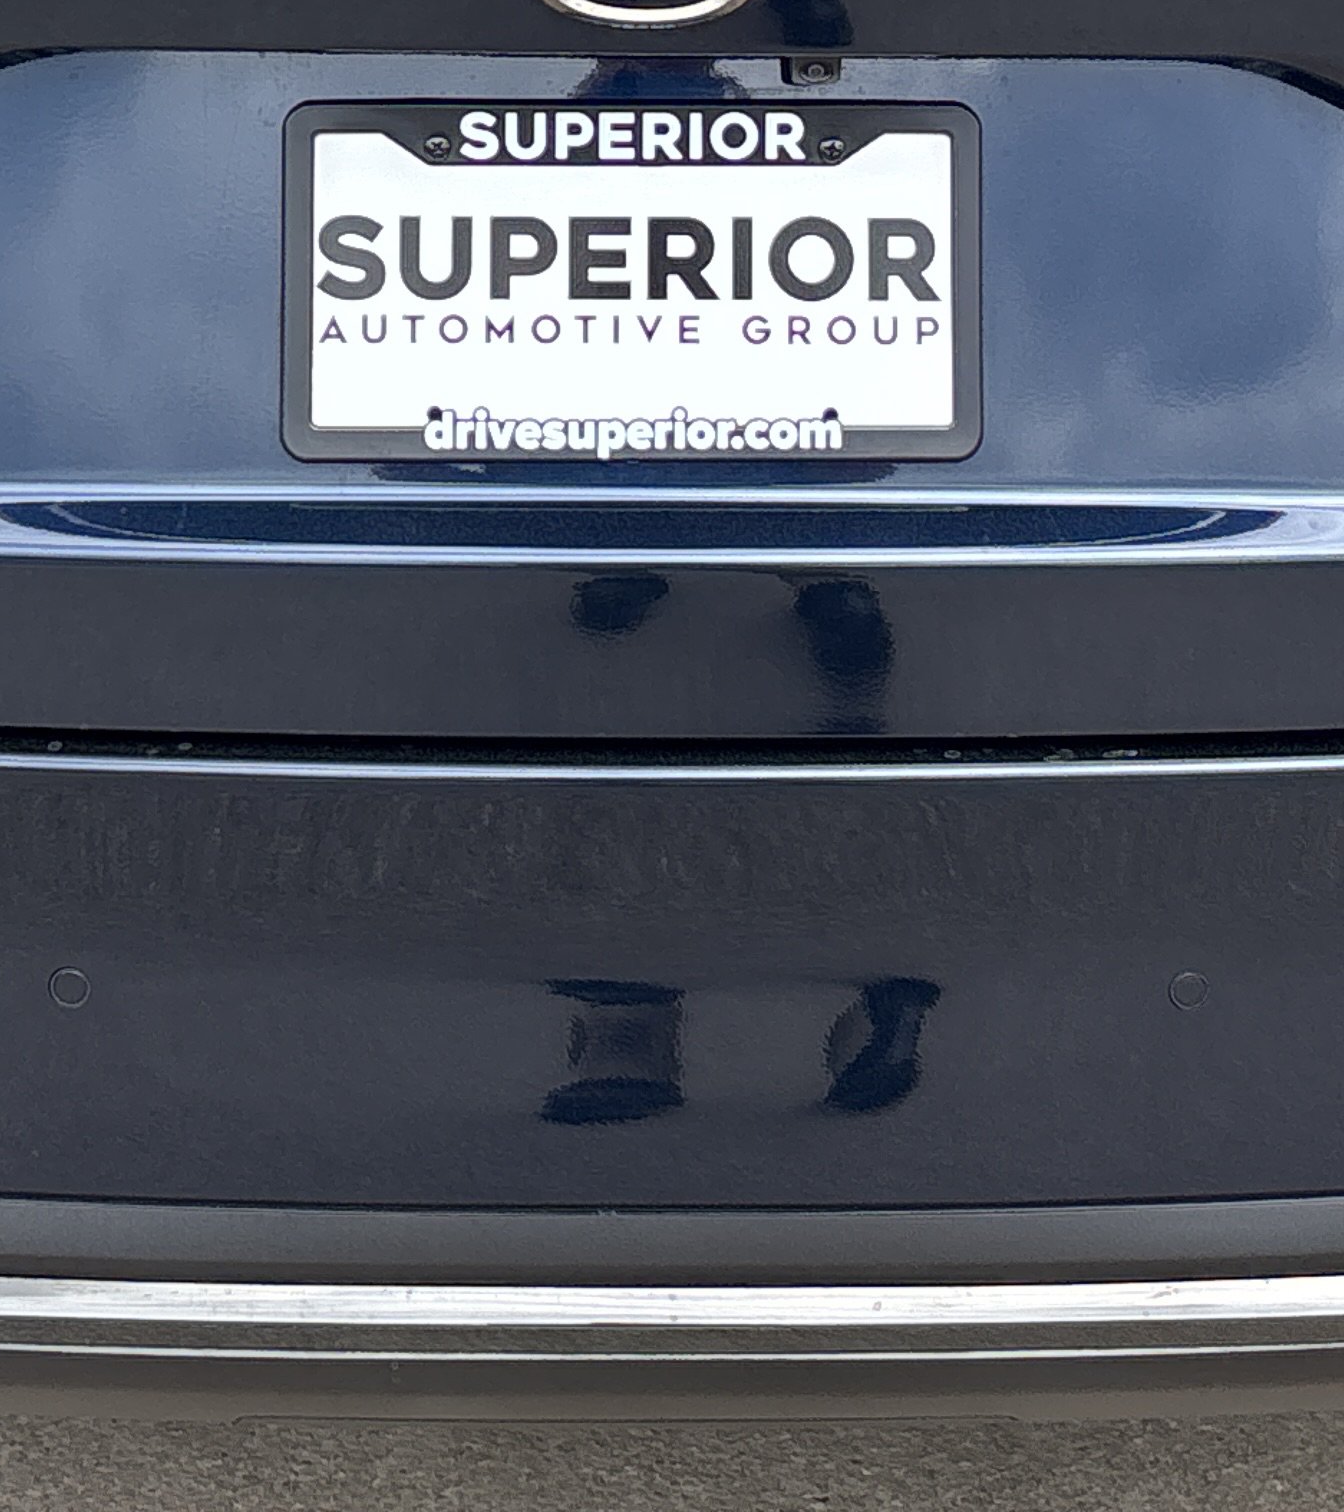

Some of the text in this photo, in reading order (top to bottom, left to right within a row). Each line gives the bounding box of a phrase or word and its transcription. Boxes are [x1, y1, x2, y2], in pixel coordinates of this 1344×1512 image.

[459, 111, 807, 162] SUPERIOR
[316, 215, 942, 301] SUPERIOR
[319, 314, 941, 346] AUTOMOTIVE GROUP
[423, 406, 844, 460] drivesuperior.com
